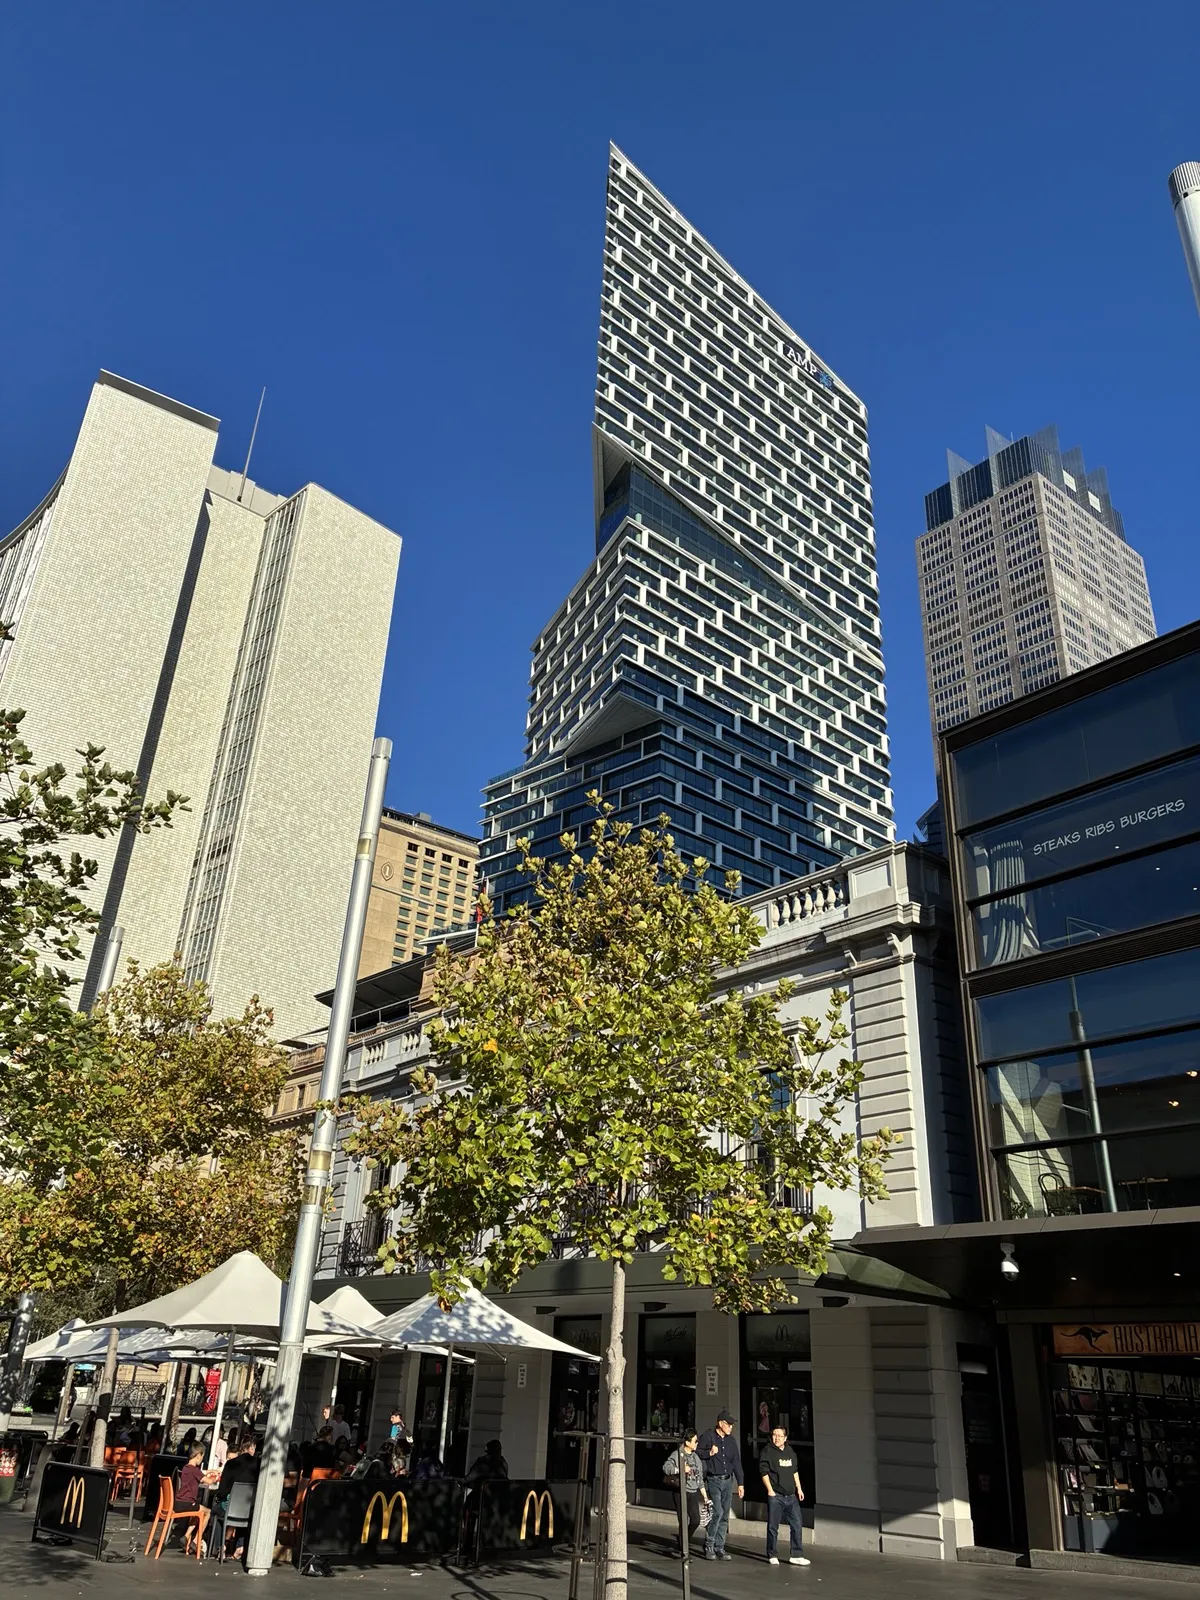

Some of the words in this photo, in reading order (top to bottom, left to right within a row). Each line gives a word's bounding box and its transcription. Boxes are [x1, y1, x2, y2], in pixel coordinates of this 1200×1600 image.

[787, 347, 817, 376] AMP
[1033, 831, 1081, 855] STEAKS
[1085, 820, 1115, 839] RIBS
[1120, 799, 1185, 828] BURGERS
[1113, 1323, 1200, 1352] AUSTRALIA
